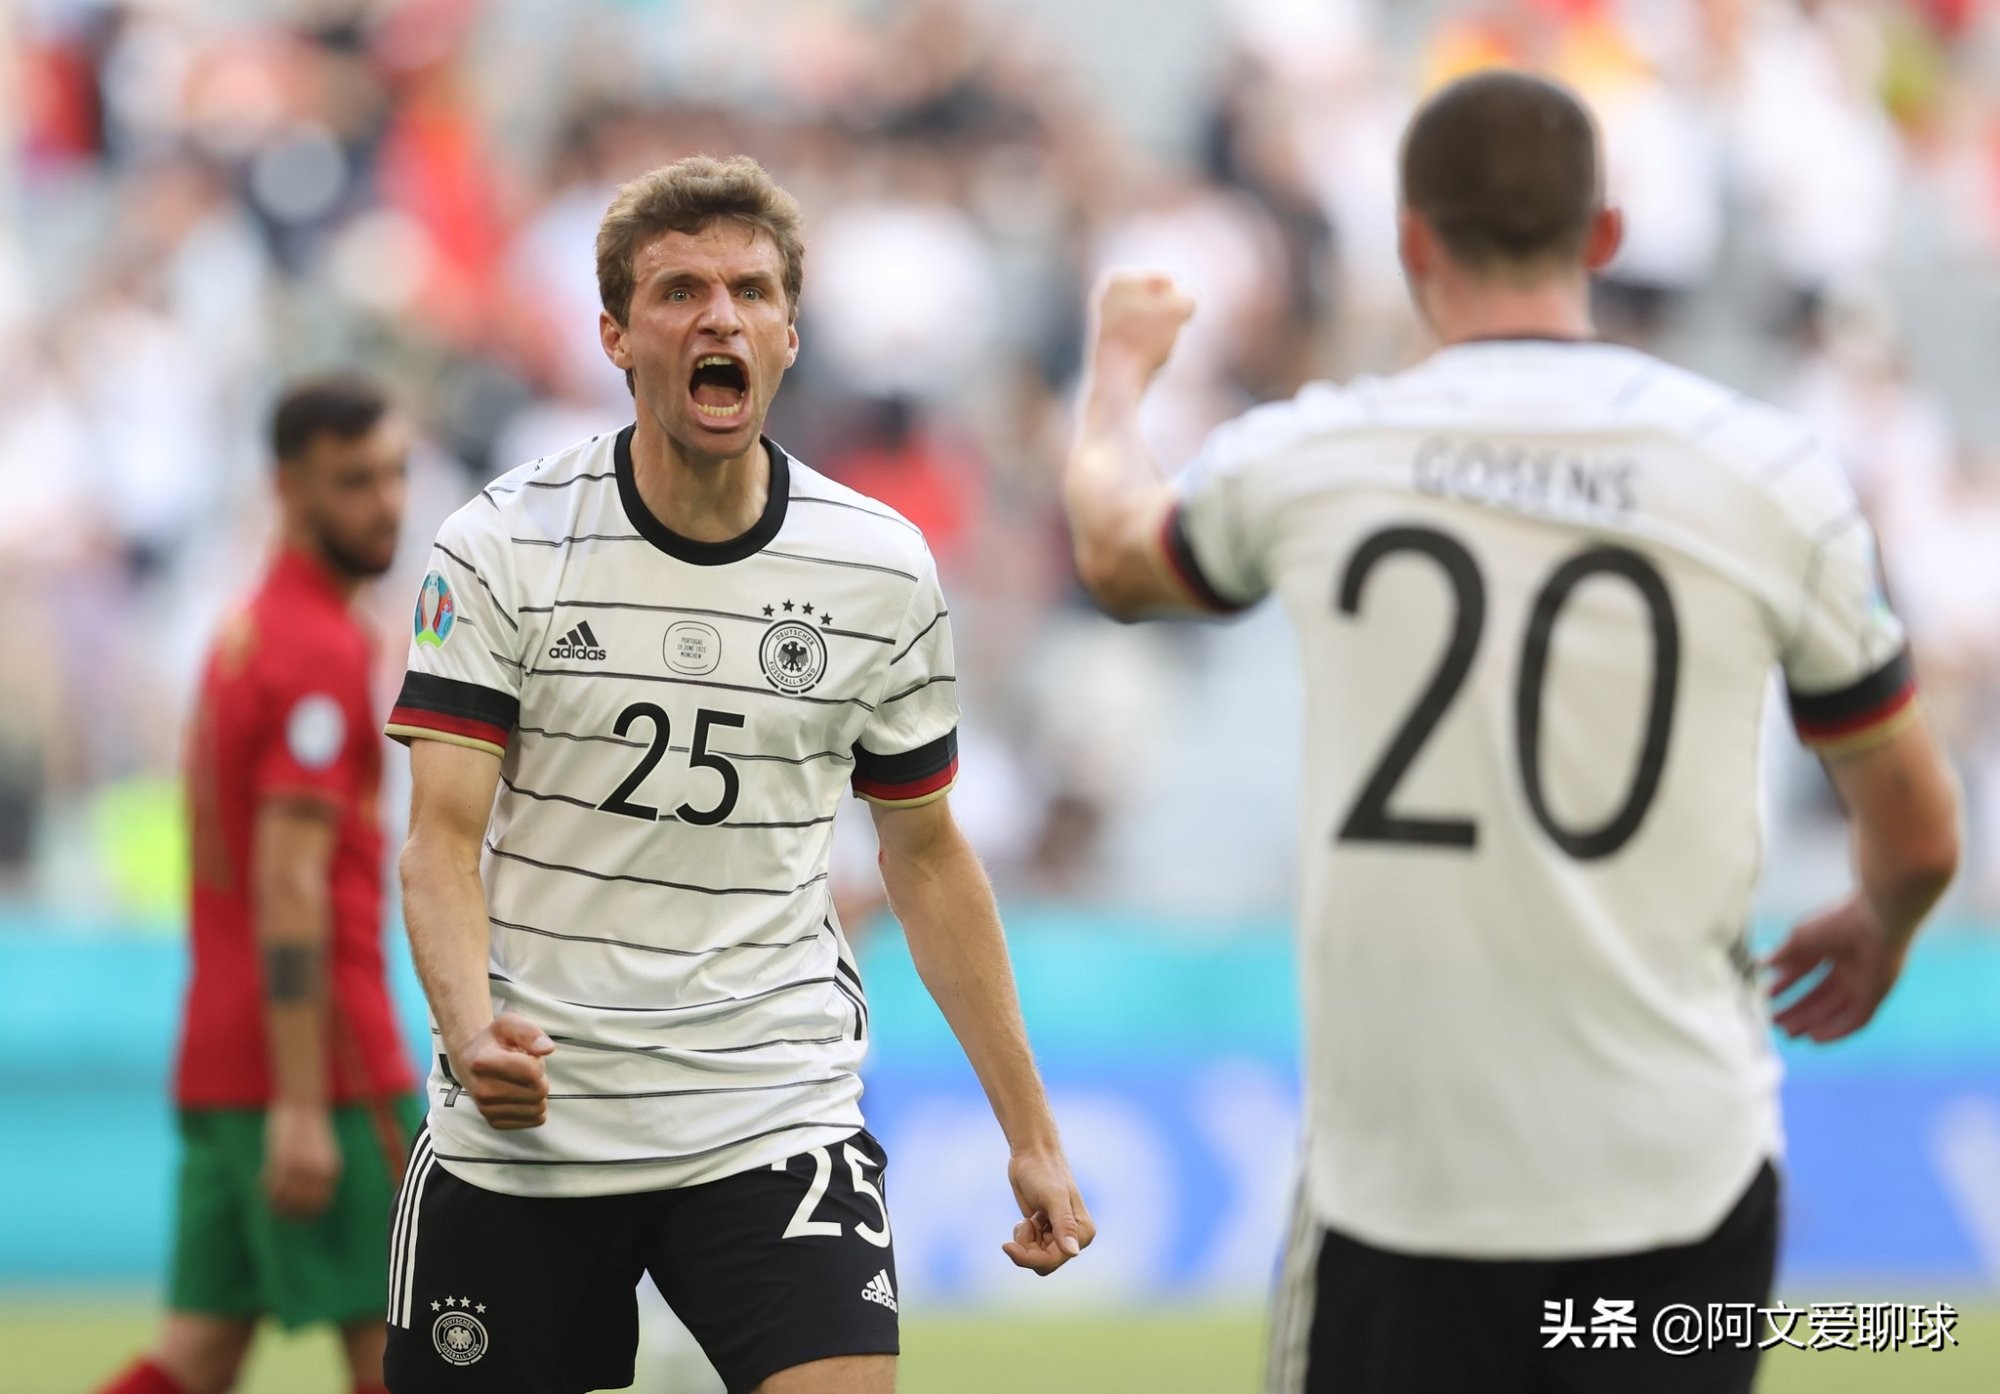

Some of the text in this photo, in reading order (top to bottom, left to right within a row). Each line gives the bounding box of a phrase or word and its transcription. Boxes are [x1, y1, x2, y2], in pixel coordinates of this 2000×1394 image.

[1413, 439, 1638, 513] GOSENS
[549, 643, 607, 661] adidas
[775, 629, 815, 646] DEUTSCHER
[1334, 521, 1681, 863] 20
[596, 702, 745, 827] 25
[771, 1143, 891, 1248] 25
[861, 1288, 898, 1313] adida
